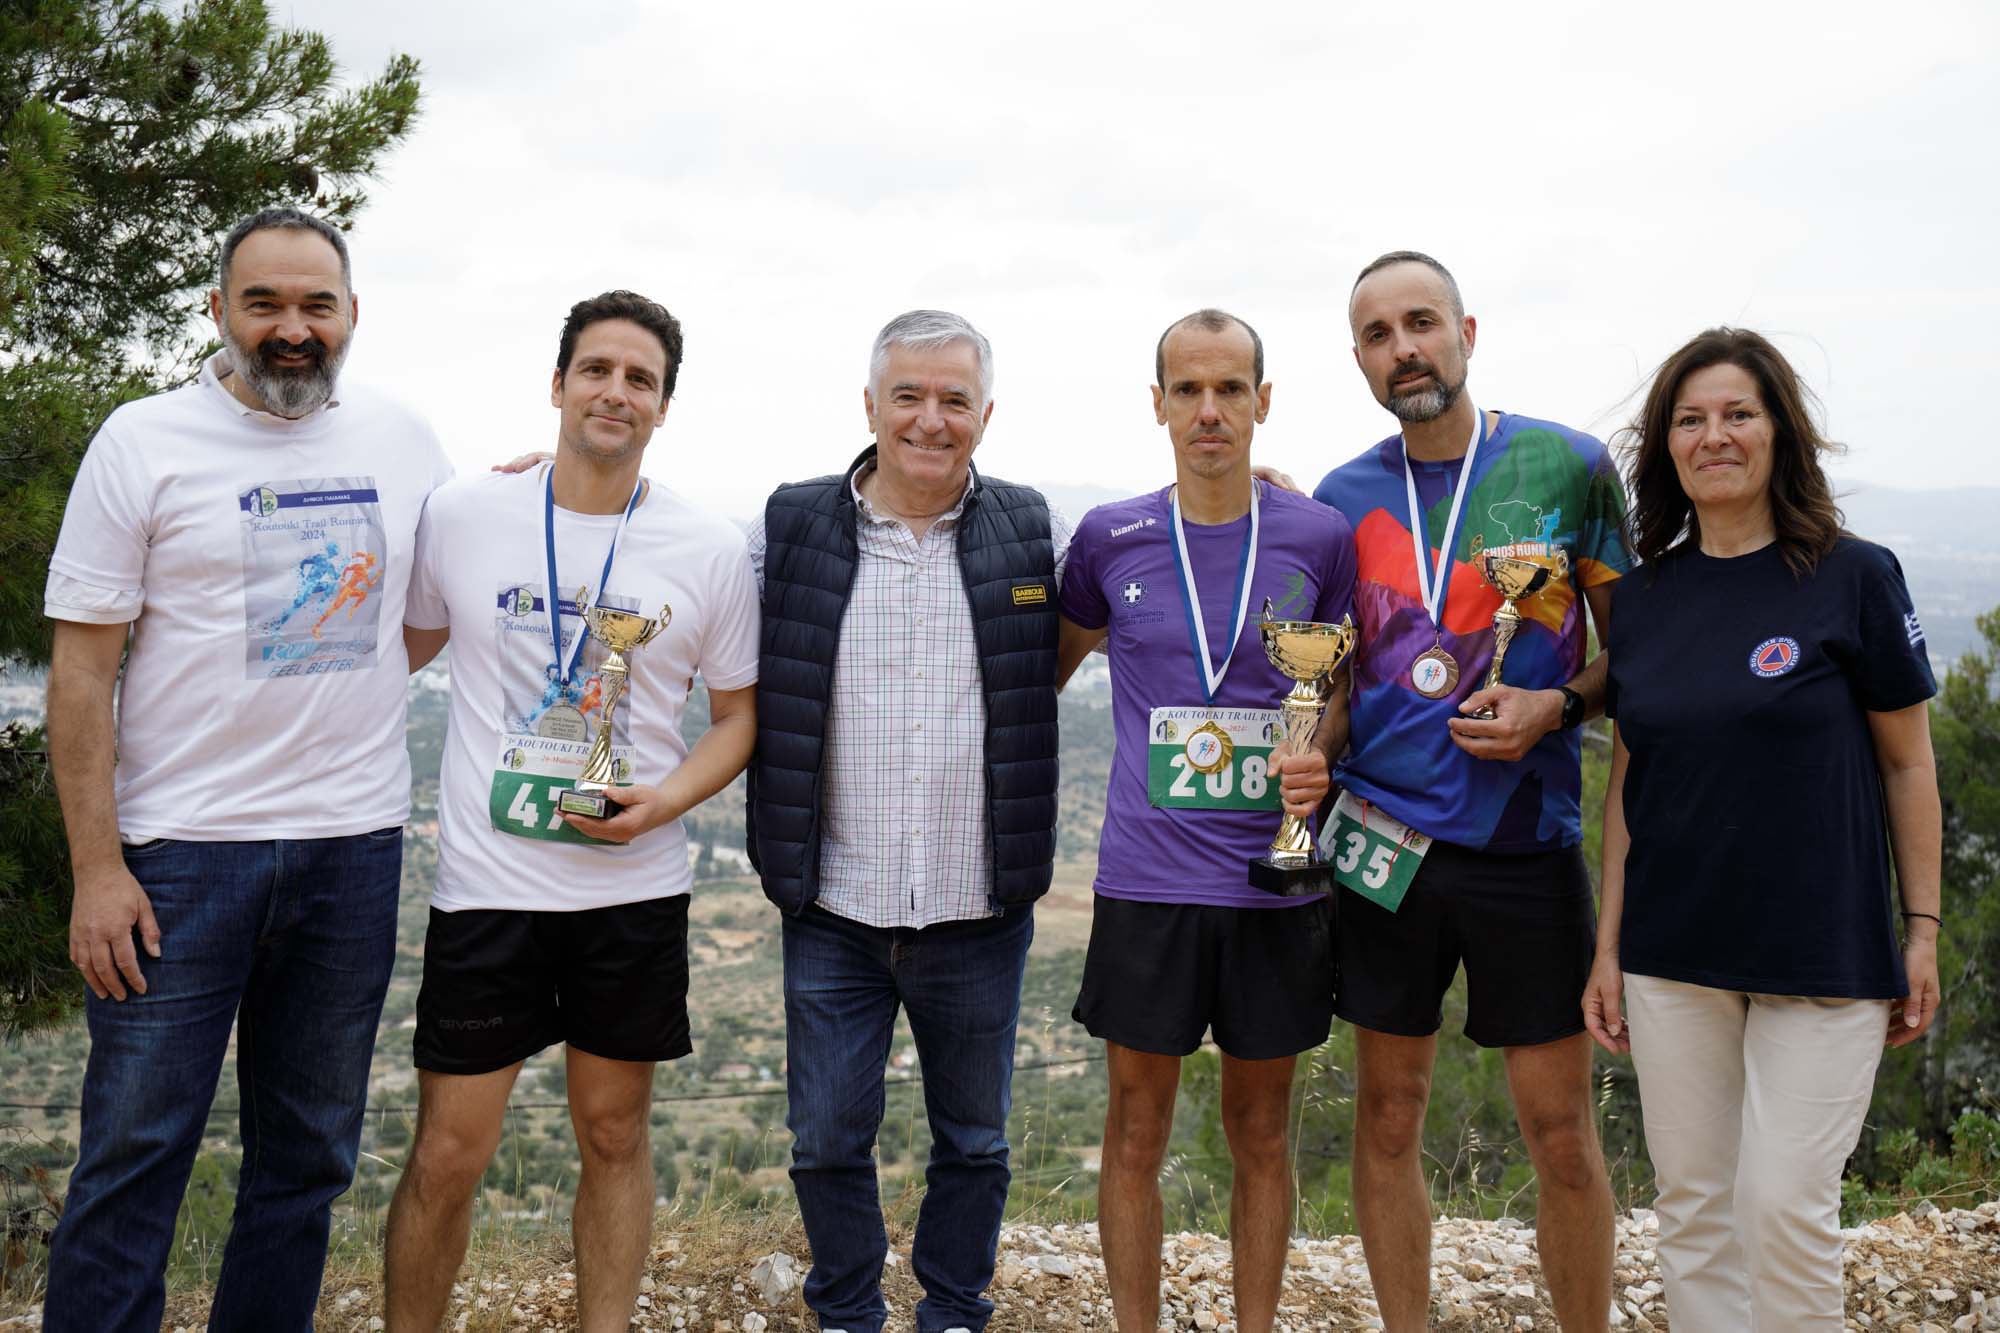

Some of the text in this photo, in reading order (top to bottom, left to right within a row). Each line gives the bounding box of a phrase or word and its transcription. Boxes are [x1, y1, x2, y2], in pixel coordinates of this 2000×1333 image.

[253, 516, 371, 532] Koutouki Trail Running
[1111, 519, 1143, 538] luanvi
[301, 530, 325, 540] 2024
[1482, 545, 1514, 559] CHIOS
[504, 621, 577, 637] Koutouki rail
[268, 659, 354, 678] FEEL BETTER
[1168, 710, 1226, 721] KOUTOUKI
[1227, 711, 1258, 721] TRAIL
[1260, 712, 1281, 721] RUN
[518, 738, 574, 754] KOUTOUKI
[1169, 752, 1268, 800] 208
[1318, 819, 1399, 890] 435
